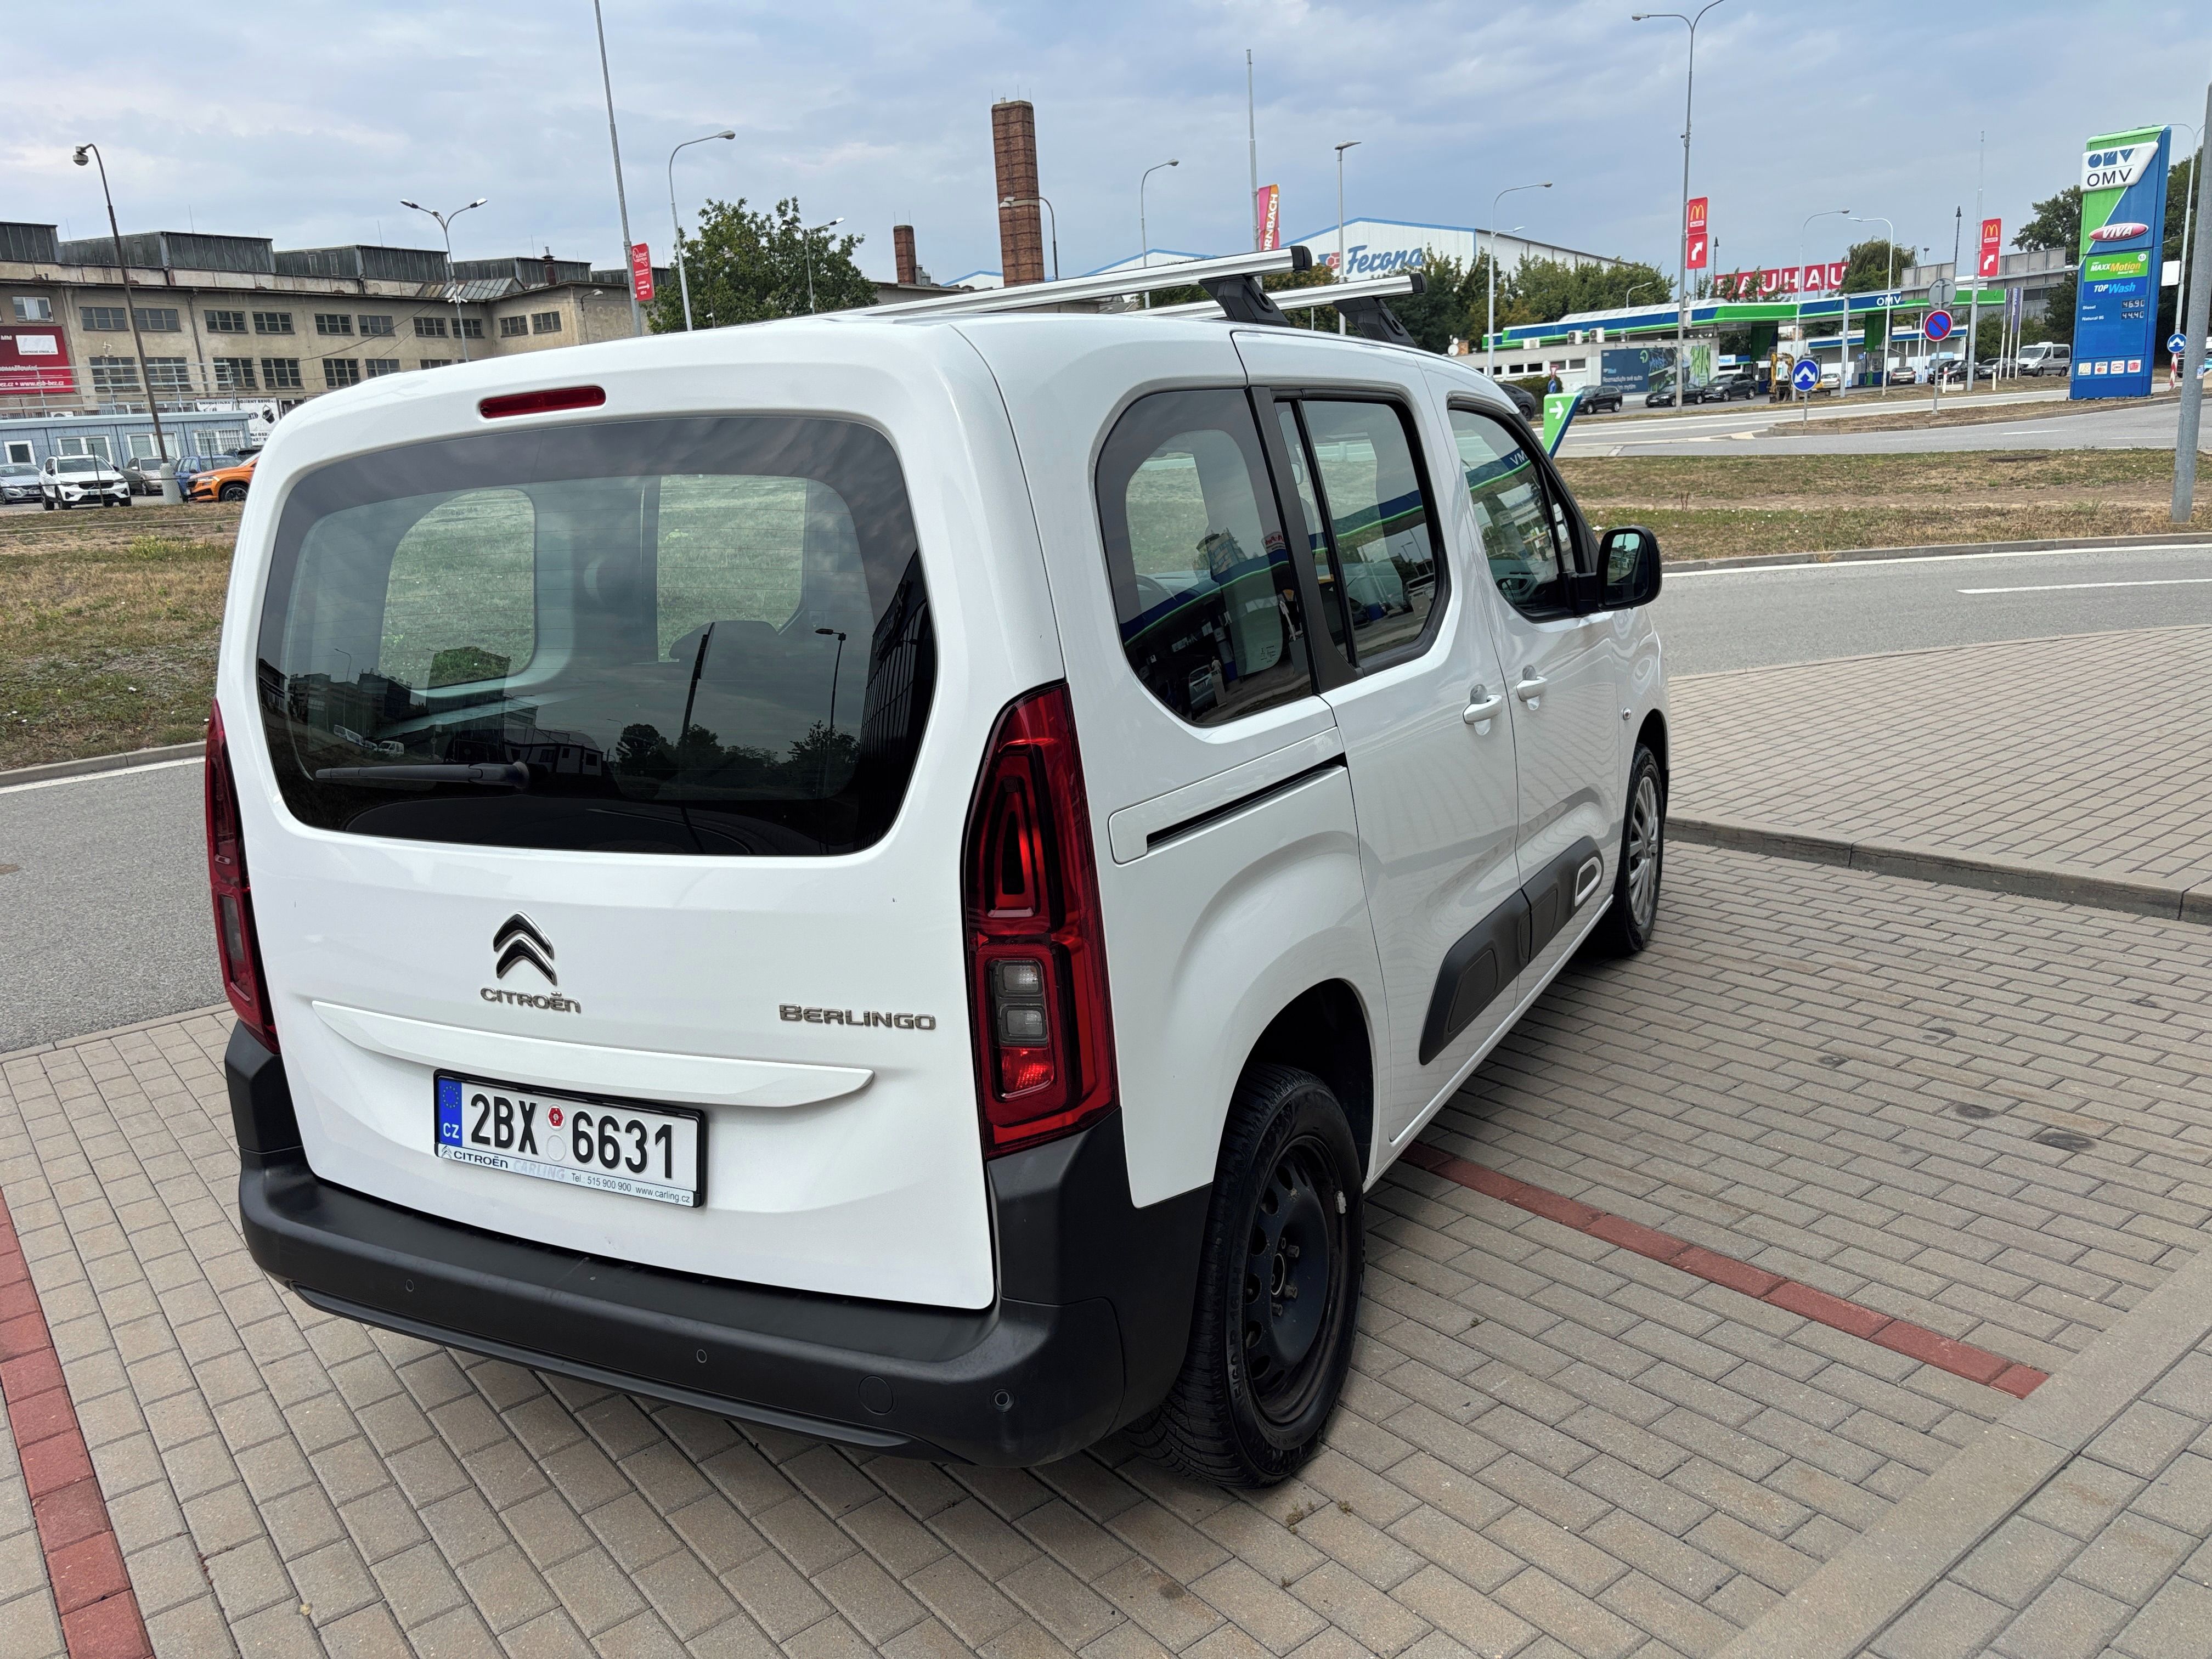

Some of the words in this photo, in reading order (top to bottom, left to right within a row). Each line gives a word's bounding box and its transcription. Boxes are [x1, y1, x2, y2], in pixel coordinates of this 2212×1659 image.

[2087, 168, 2132, 187] OMV
[2102, 225, 2133, 239] VIVA
[1346, 245, 1423, 275] Ferona
[1876, 295, 1901, 306] OMV
[780, 1003, 936, 1030] BERLINGO
[443, 1122, 460, 1139] CZ
[471, 1094, 538, 1155] 2BX
[573, 1111, 672, 1179] 6631
[514, 1160, 565, 1180] CARLING
[588, 1176, 601, 1186] 515
[603, 1179, 616, 1189] 900
[618, 1182, 631, 1192] 900
[636, 1187, 690, 1203] www.carling.cz
